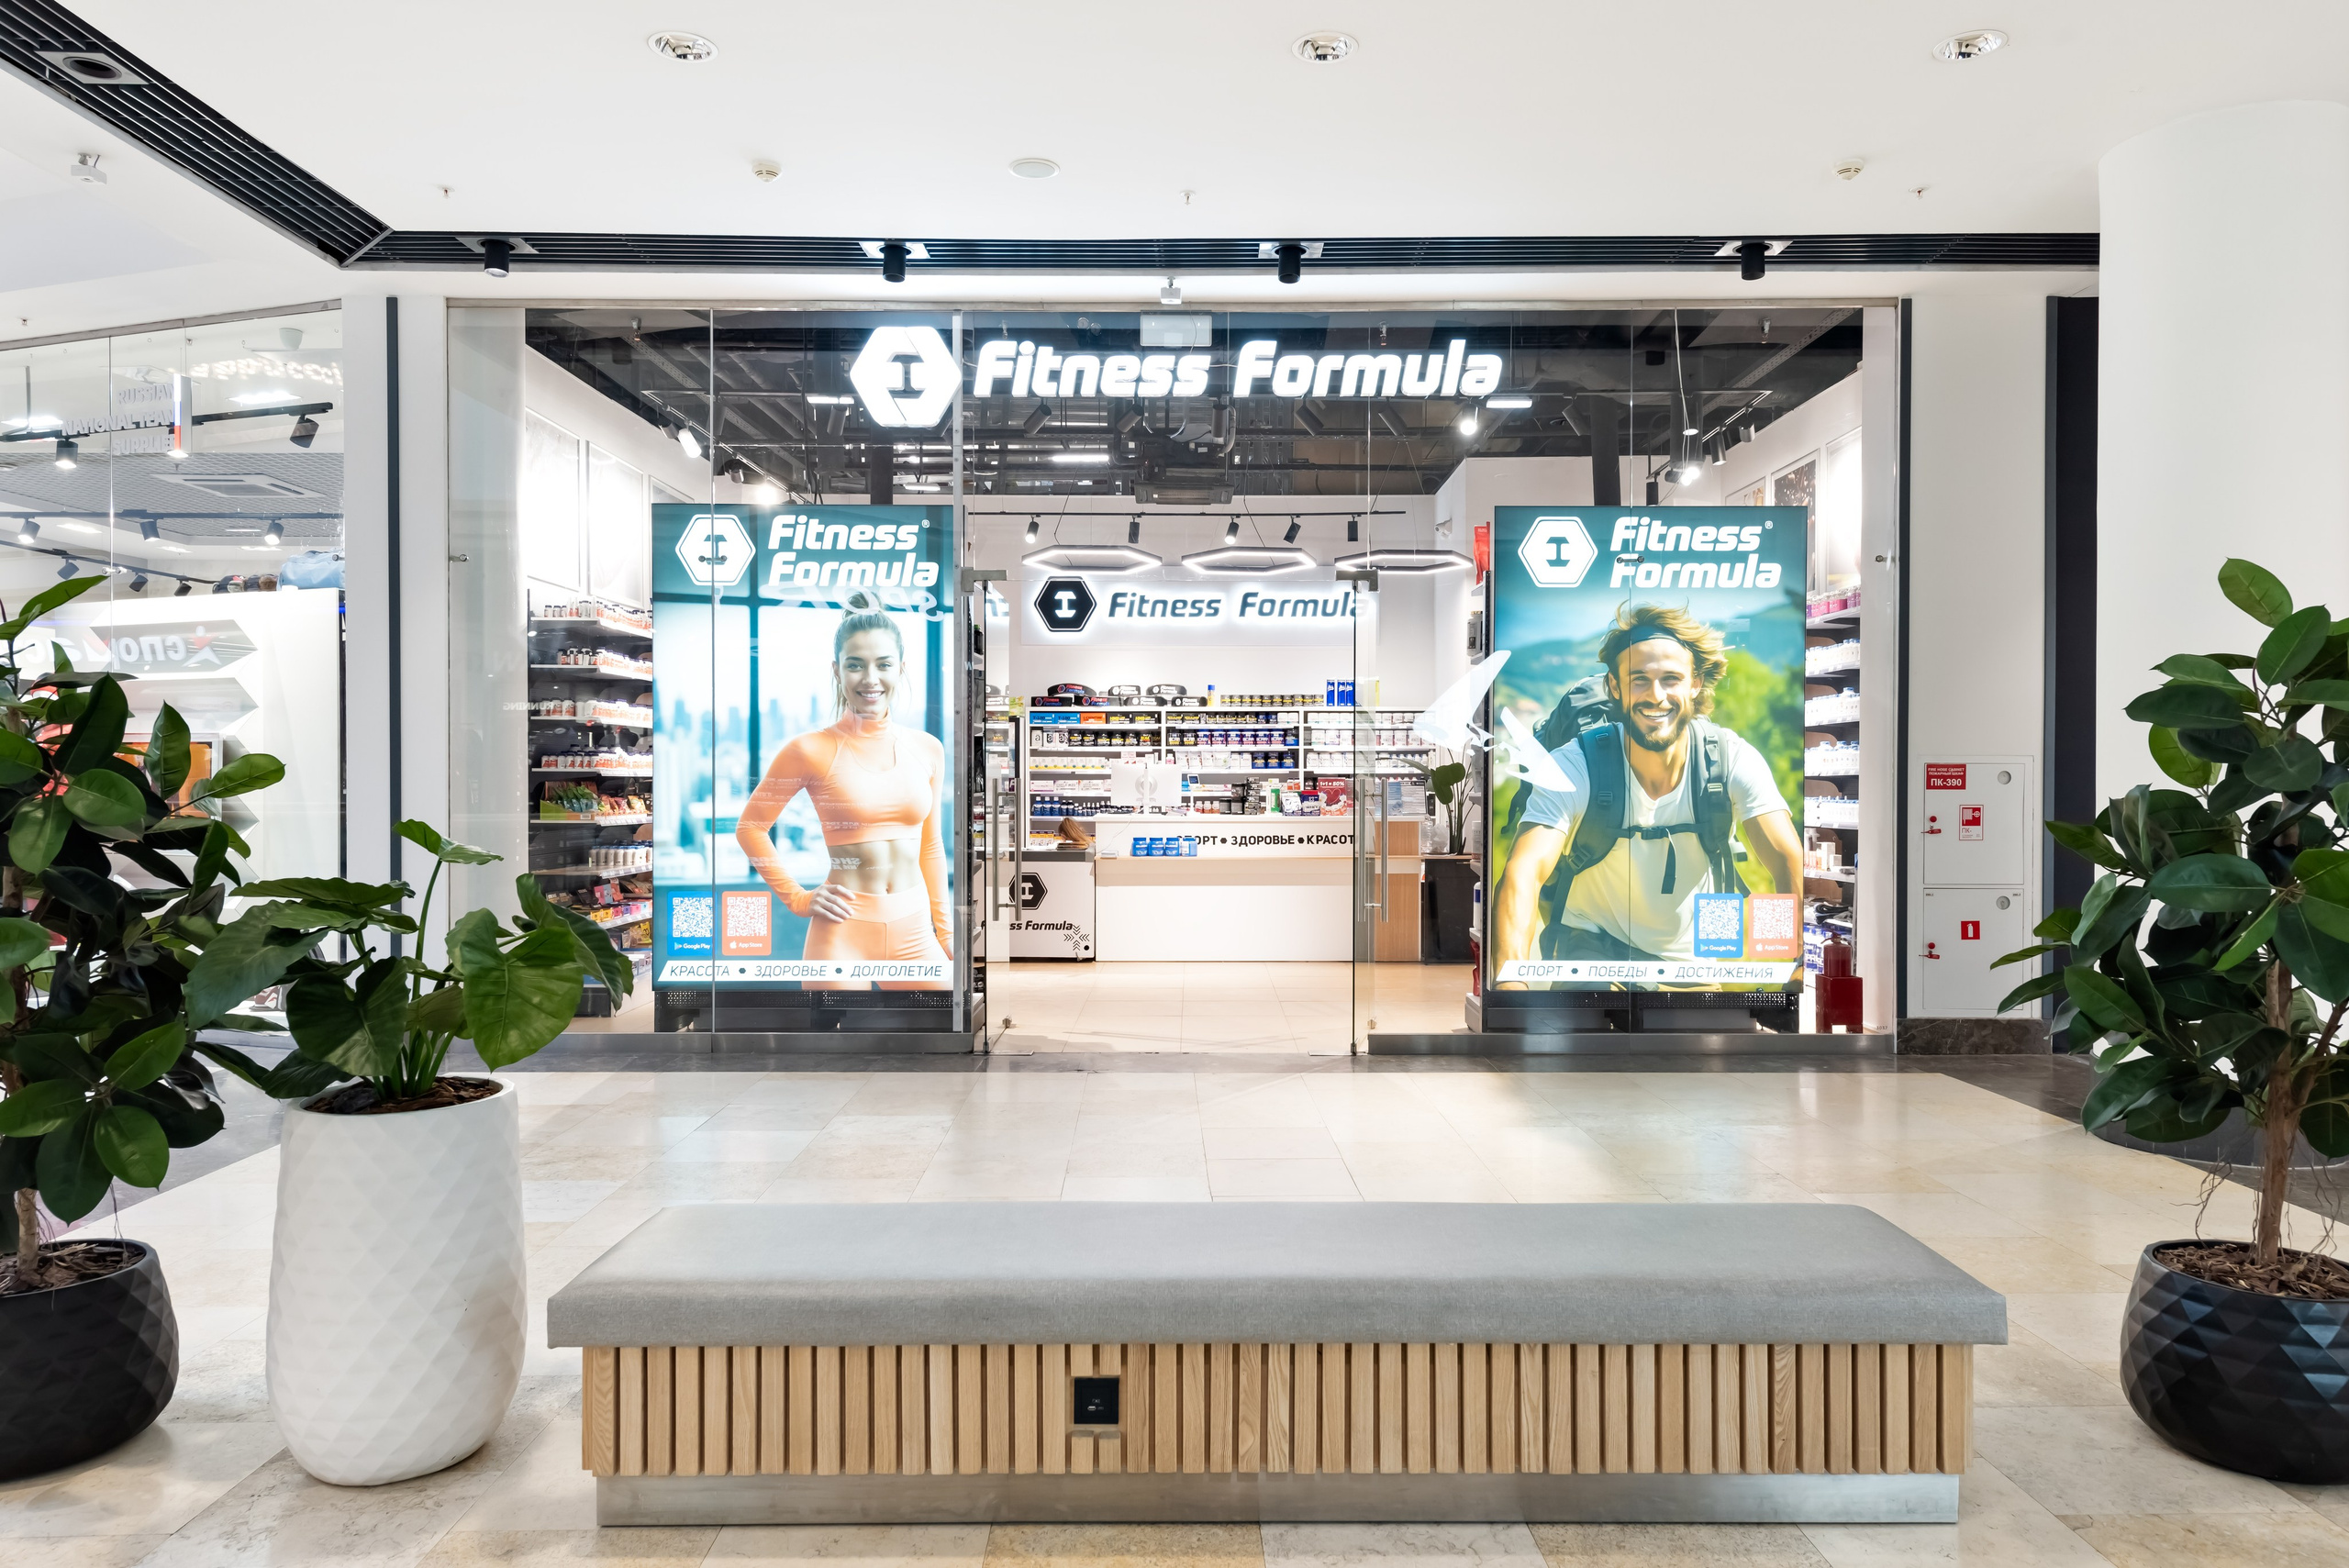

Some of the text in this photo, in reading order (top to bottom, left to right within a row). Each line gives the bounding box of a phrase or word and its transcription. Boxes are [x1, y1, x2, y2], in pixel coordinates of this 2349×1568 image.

[974, 339, 1503, 399] Fitness Formula
[61, 413, 135, 436] NATIONAL
[768, 551, 940, 587] Formula
[1609, 553, 1782, 588] Formula
[1108, 592, 1221, 617] Fitness
[1931, 778, 1962, 786] ПК-390
[1230, 835, 1295, 847] ЗДОРОВЬЕ
[1307, 834, 1354, 845] КРАСОТ
[1025, 920, 1074, 930] Formula
[670, 965, 942, 978] КРАСОТА ЗДОРОВЬЕ ДОЛГОЛЕТИЕ
[1518, 965, 1773, 979] СПОРТ ПОБЕДЫ ДОСТИЖЕНИЯ
